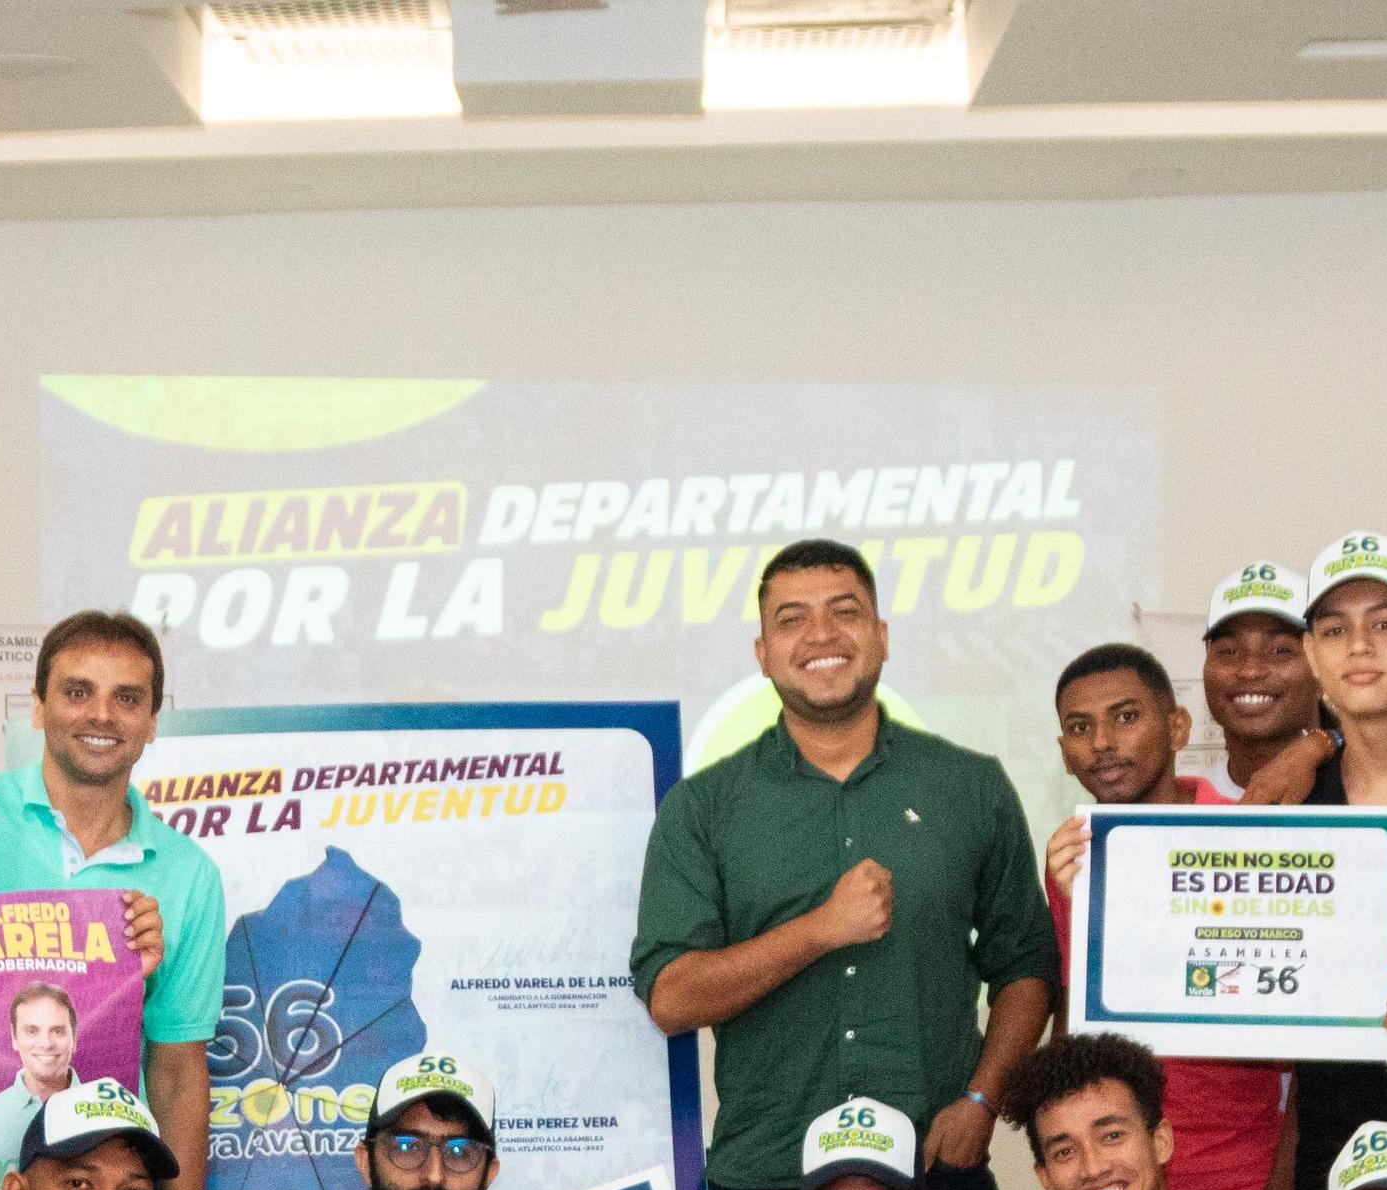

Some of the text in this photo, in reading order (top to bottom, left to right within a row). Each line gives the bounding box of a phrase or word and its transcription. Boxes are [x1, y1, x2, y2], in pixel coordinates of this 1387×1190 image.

[141, 459, 1081, 561] ALIANZA DEPARTAMENTAL
[1342, 536, 1379, 555] 56
[1241, 564, 1276, 582] 56
[375, 557, 504, 641] LA
[539, 531, 1085, 632] JUVTUD
[145, 750, 564, 804] ALIANZA DEPARTAMENTAL
[245, 782, 569, 833] LA JUVENTUD
[1172, 852, 1334, 869] JOVEN NO SOLO
[1172, 871, 1335, 894] ES DE EDAD
[1232, 898, 1336, 917] DE IDEAS
[1197, 929, 1218, 939] POR
[1243, 929, 1257, 939] YO
[1188, 948, 1308, 959] ASAMBLEA
[451, 976, 635, 990] ALFREDO VARELA DE LA ROS
[1257, 966, 1299, 995] 56
[209, 979, 343, 1078] 56
[418, 1056, 457, 1074] 56
[98, 1082, 135, 1106] 56
[537, 1117, 618, 1129] PEREZ VERA
[838, 1107, 876, 1129] 56
